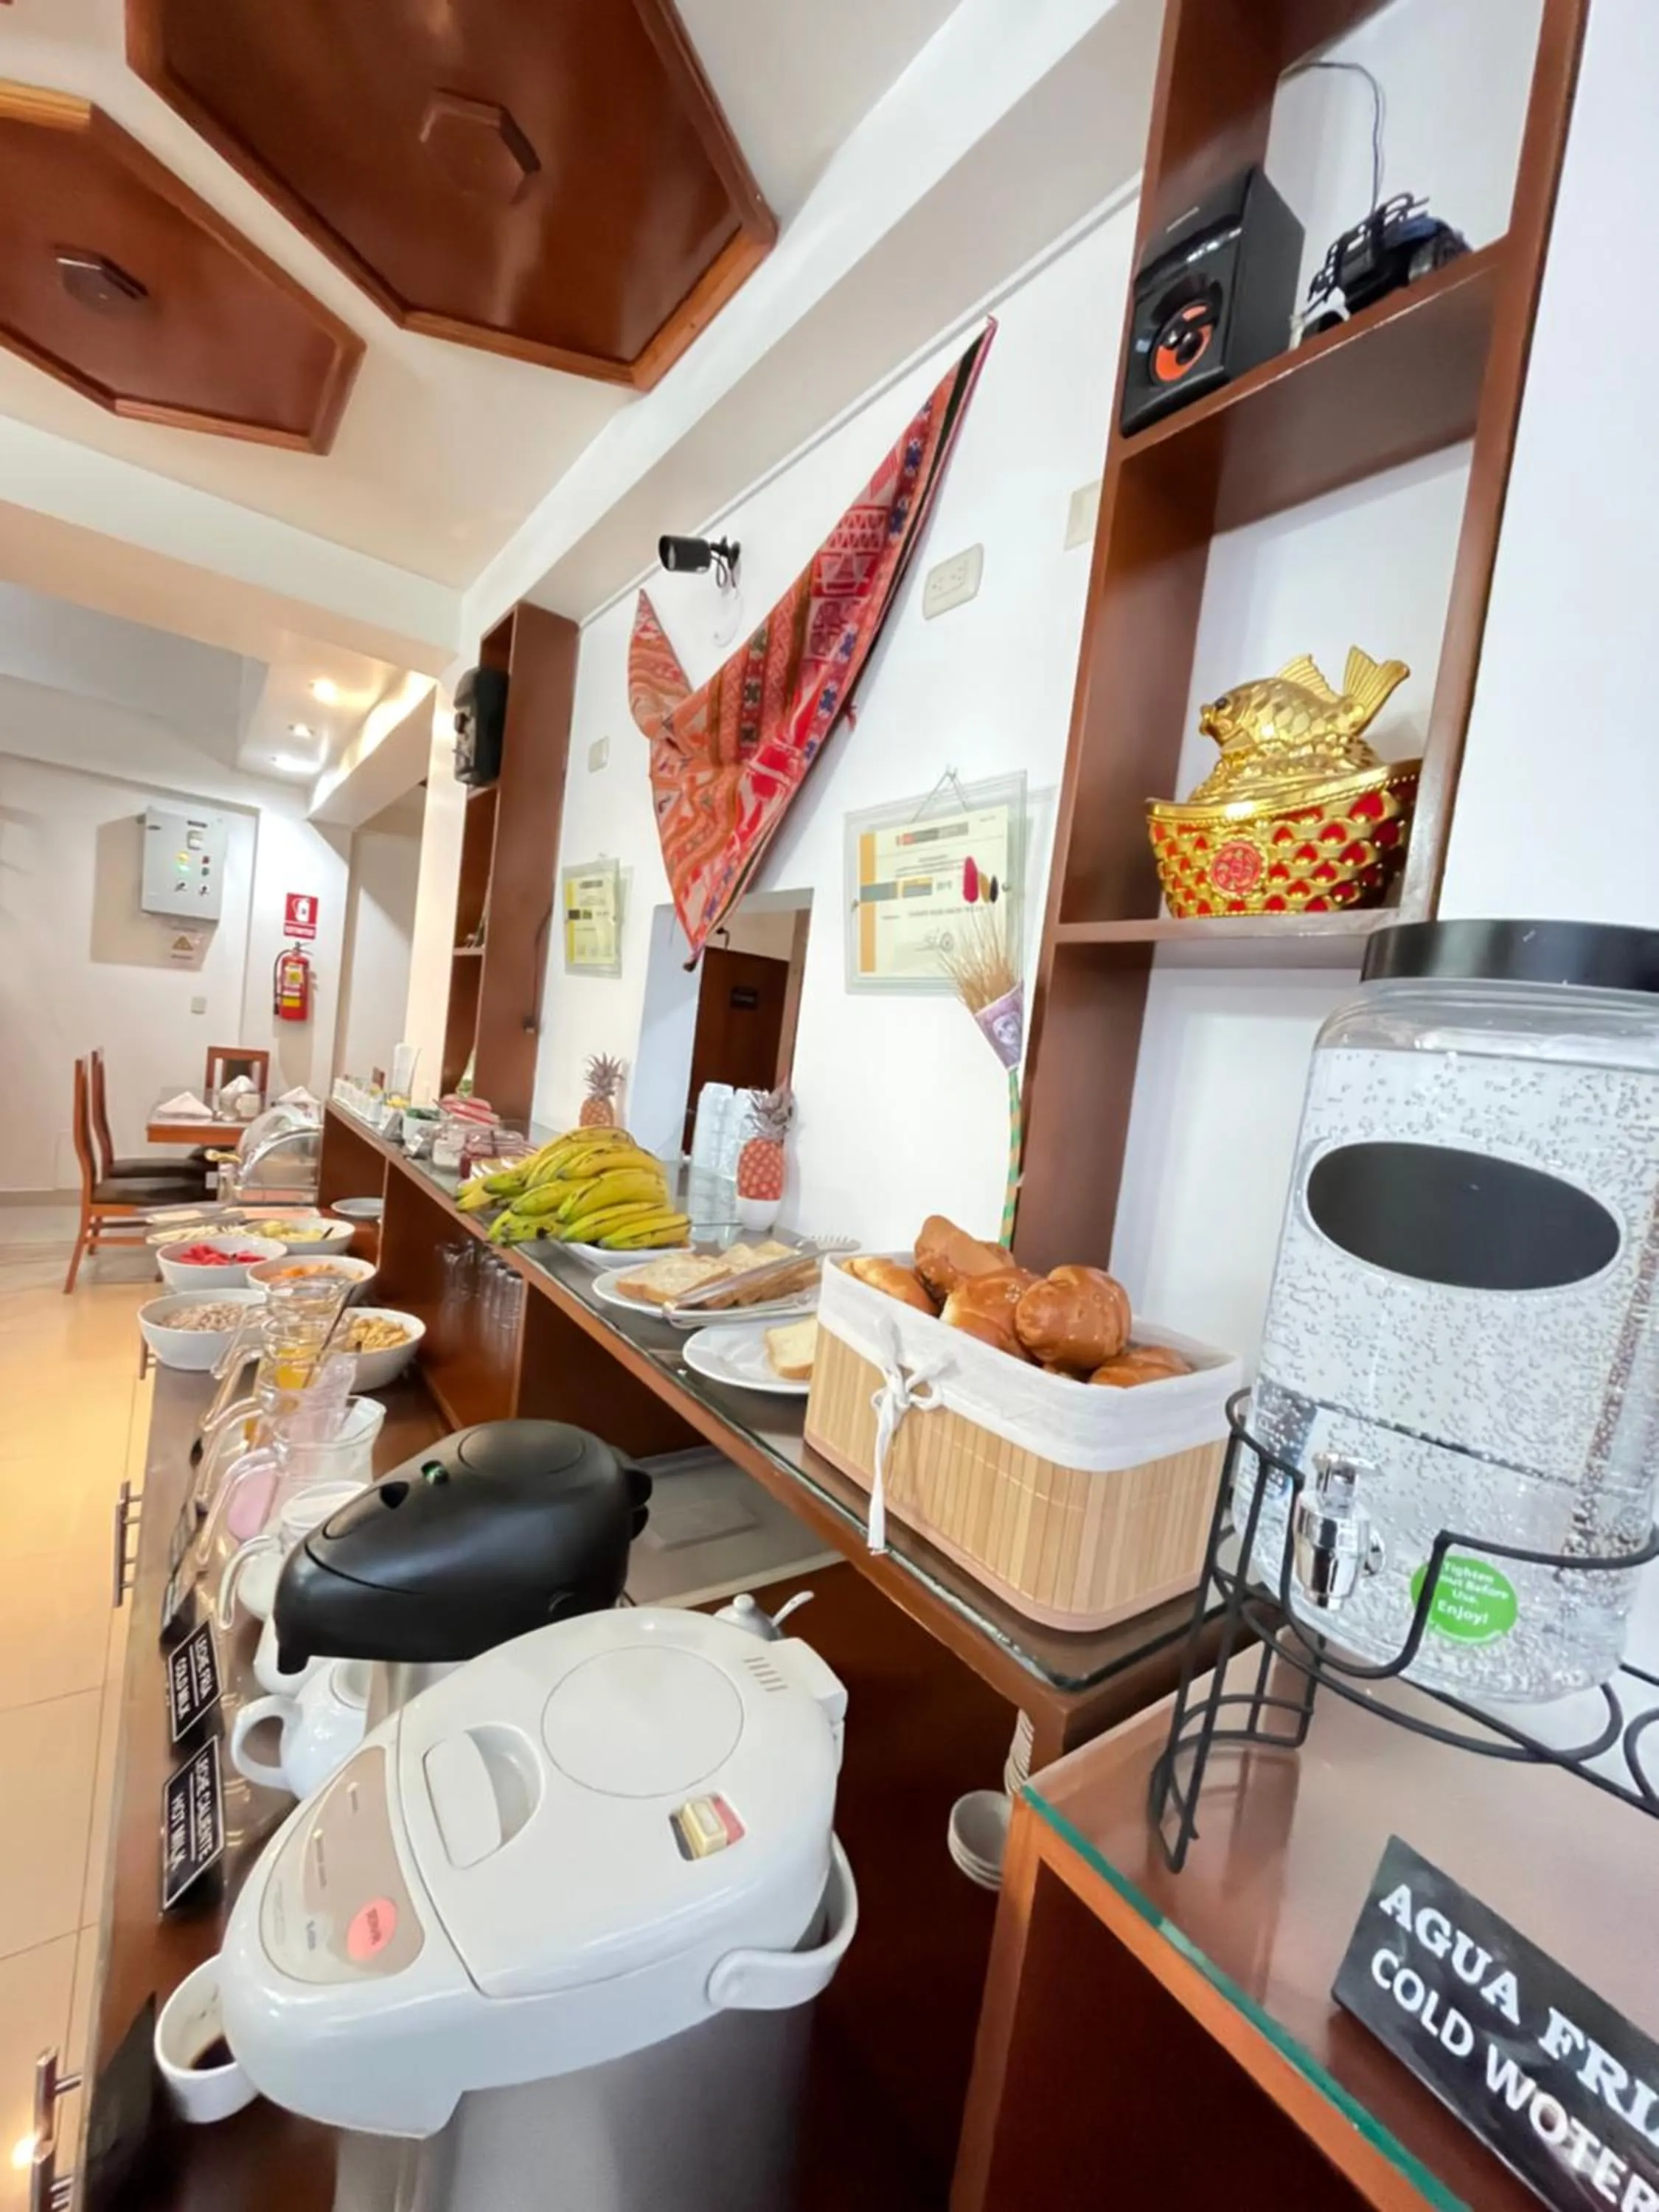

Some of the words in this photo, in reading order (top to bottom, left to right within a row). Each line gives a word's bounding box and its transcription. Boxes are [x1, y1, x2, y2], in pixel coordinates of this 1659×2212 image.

[1437, 1599, 1489, 1626] Enjoy!
[1371, 1948, 1474, 2058] COLD
[1378, 1883, 1521, 2026] AGUA
[1537, 2006, 1659, 2149] FRI
